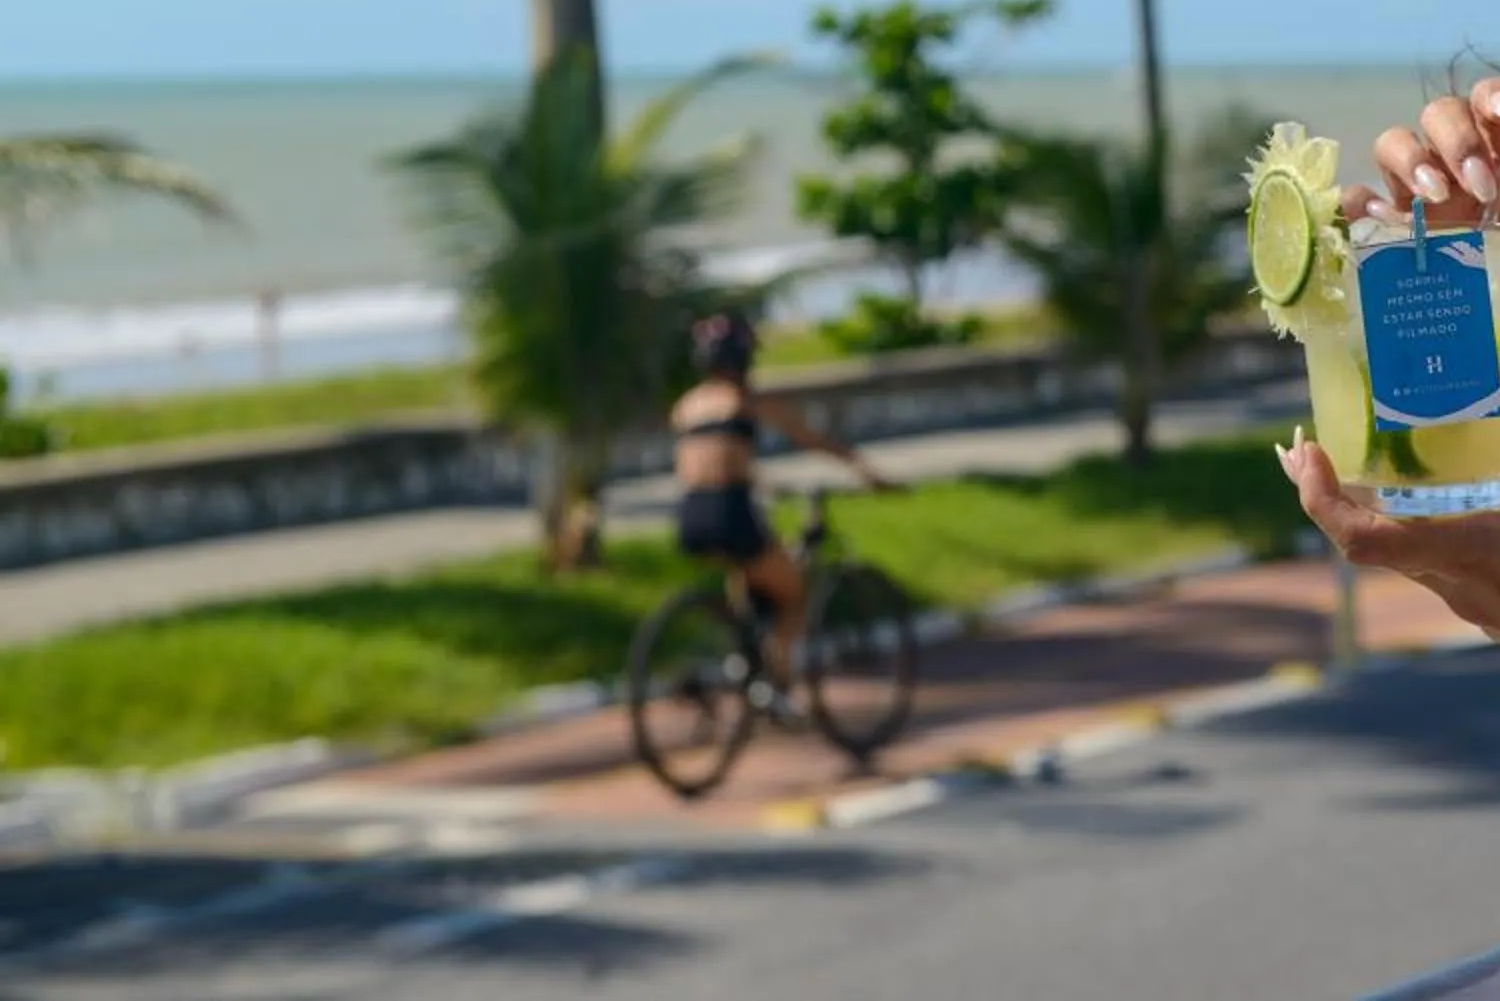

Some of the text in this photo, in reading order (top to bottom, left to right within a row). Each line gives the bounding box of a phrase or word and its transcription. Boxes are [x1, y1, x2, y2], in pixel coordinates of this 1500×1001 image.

[1437, 287, 1463, 300] SEM
[1382, 304, 1472, 325] ESTAR SENDO
[1397, 323, 1458, 339] FILMADO
